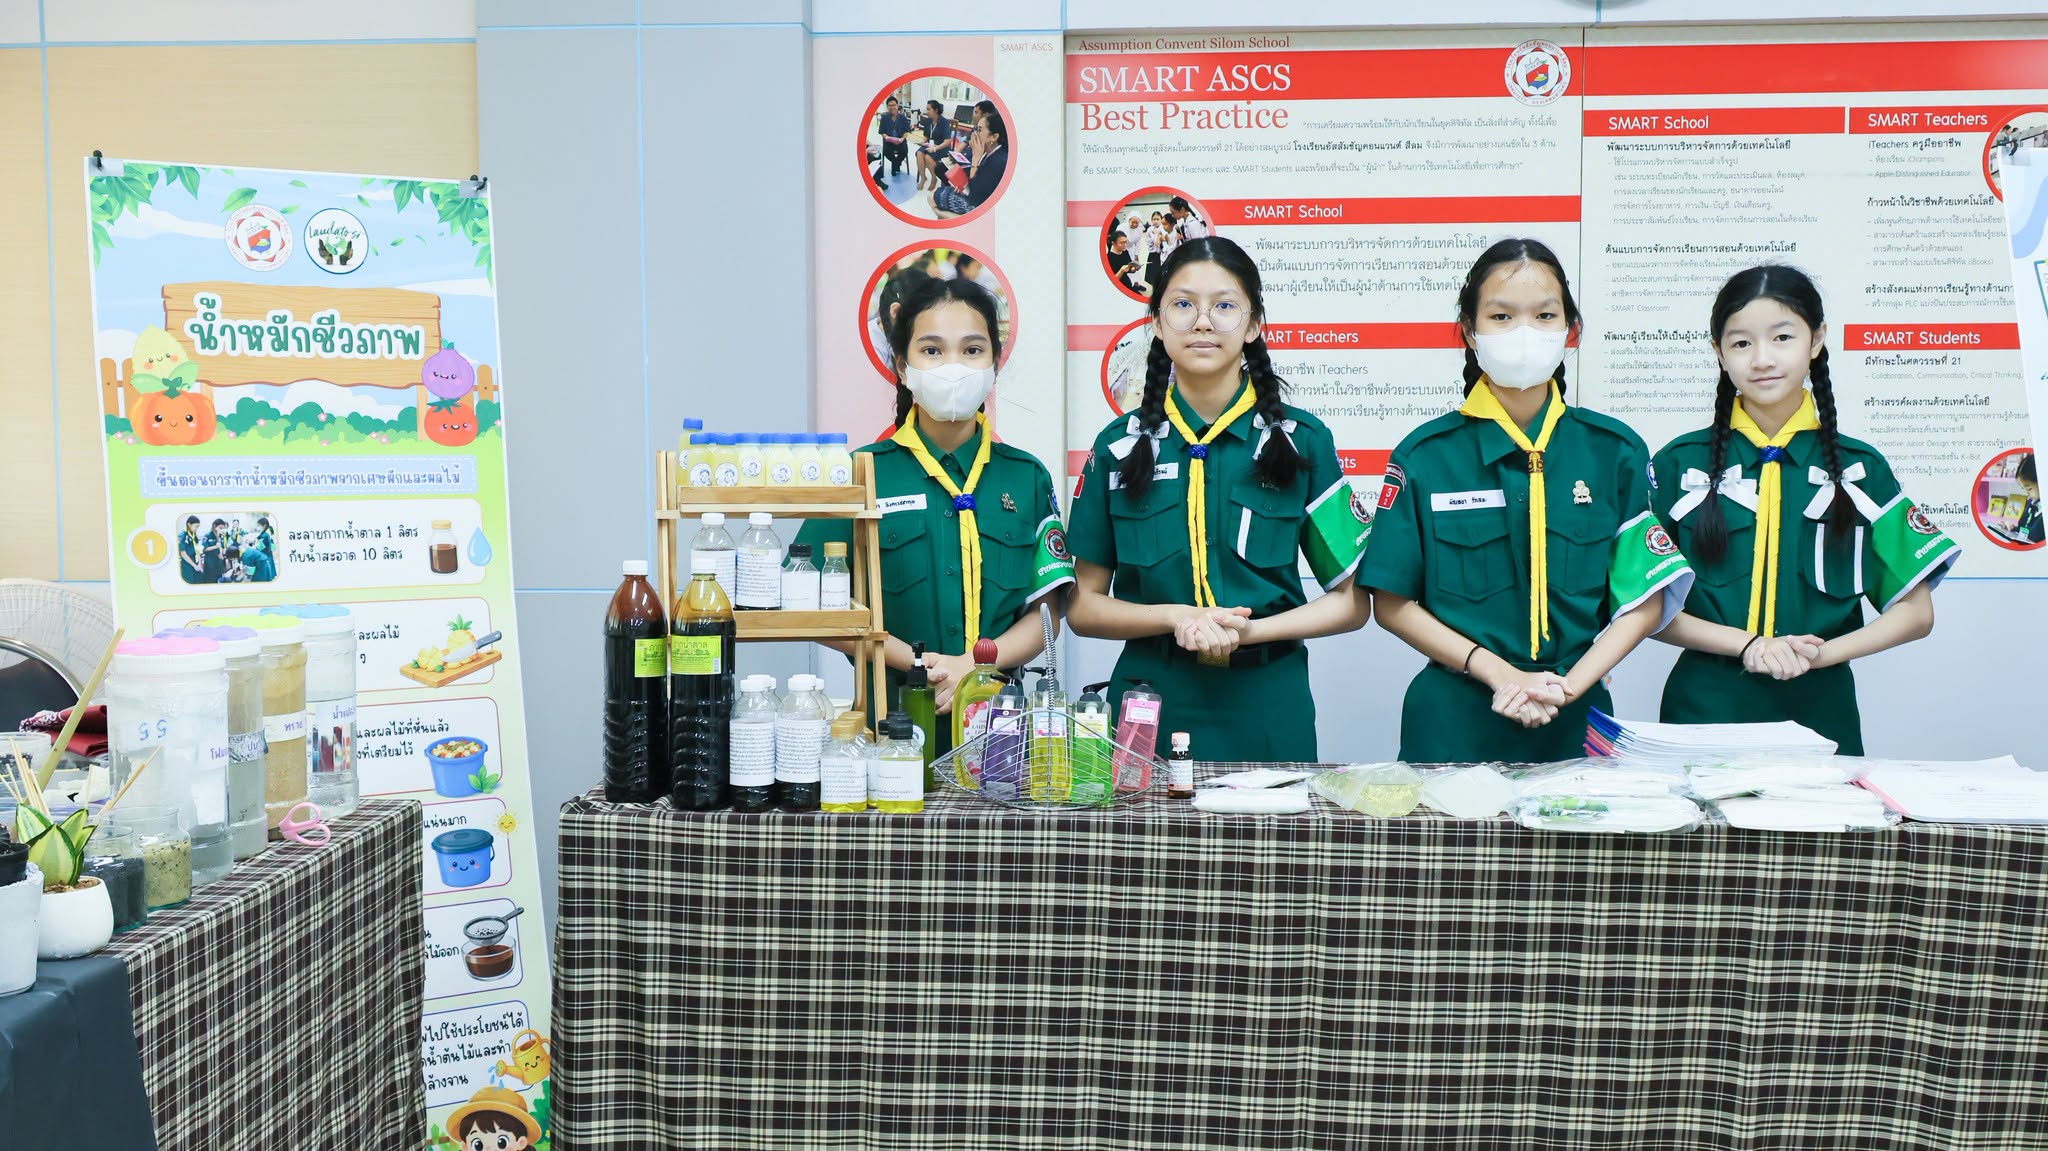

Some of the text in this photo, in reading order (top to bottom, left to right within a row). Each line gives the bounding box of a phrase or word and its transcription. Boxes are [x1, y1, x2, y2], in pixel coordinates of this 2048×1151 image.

[1000, 42, 1054, 52] SMART ASCS
[1079, 35, 1290, 53] Assumption Convent Silom School
[1079, 63, 1292, 94] SMART ASCS
[1080, 99, 1289, 131] Best Practice
[1868, 112, 1988, 127] SMART Teachers
[1609, 115, 1709, 130] SMART School
[1224, 144, 1233, 152] 21
[1532, 139, 1538, 148] 3
[1868, 140, 1909, 149] iTeachers
[1152, 166, 1179, 174] SMART
[1181, 166, 1213, 174] Teachers
[1232, 165, 1259, 173] SMART
[1261, 165, 1293, 173] Students
[1244, 203, 1343, 219] SMART School
[1255, 234, 1488, 250] พัฒนาระบบการบริหารจัดการด้วยเทคโนโลยี
[1611, 304, 1635, 312] SMART
[189, 296, 422, 356] น้ำหมักชีวภาพ
[1262, 329, 1359, 343] ART Teachers
[1604, 329, 1712, 343] พัฒนาผู้เรียนให้เป็นผู้นำด้
[1863, 331, 1981, 345] SMART Students
[1951, 356, 1961, 365] 21
[1318, 364, 1369, 375] iTeachers
[1385, 487, 1393, 498] 3
[1383, 498, 1389, 506] 2
[288, 520, 419, 542] ละลายกากน้ำตาล 1 ลิตร
[144, 537, 156, 557] 1
[288, 543, 404, 564] กับน้ำสะอาด 10 ลิตร
